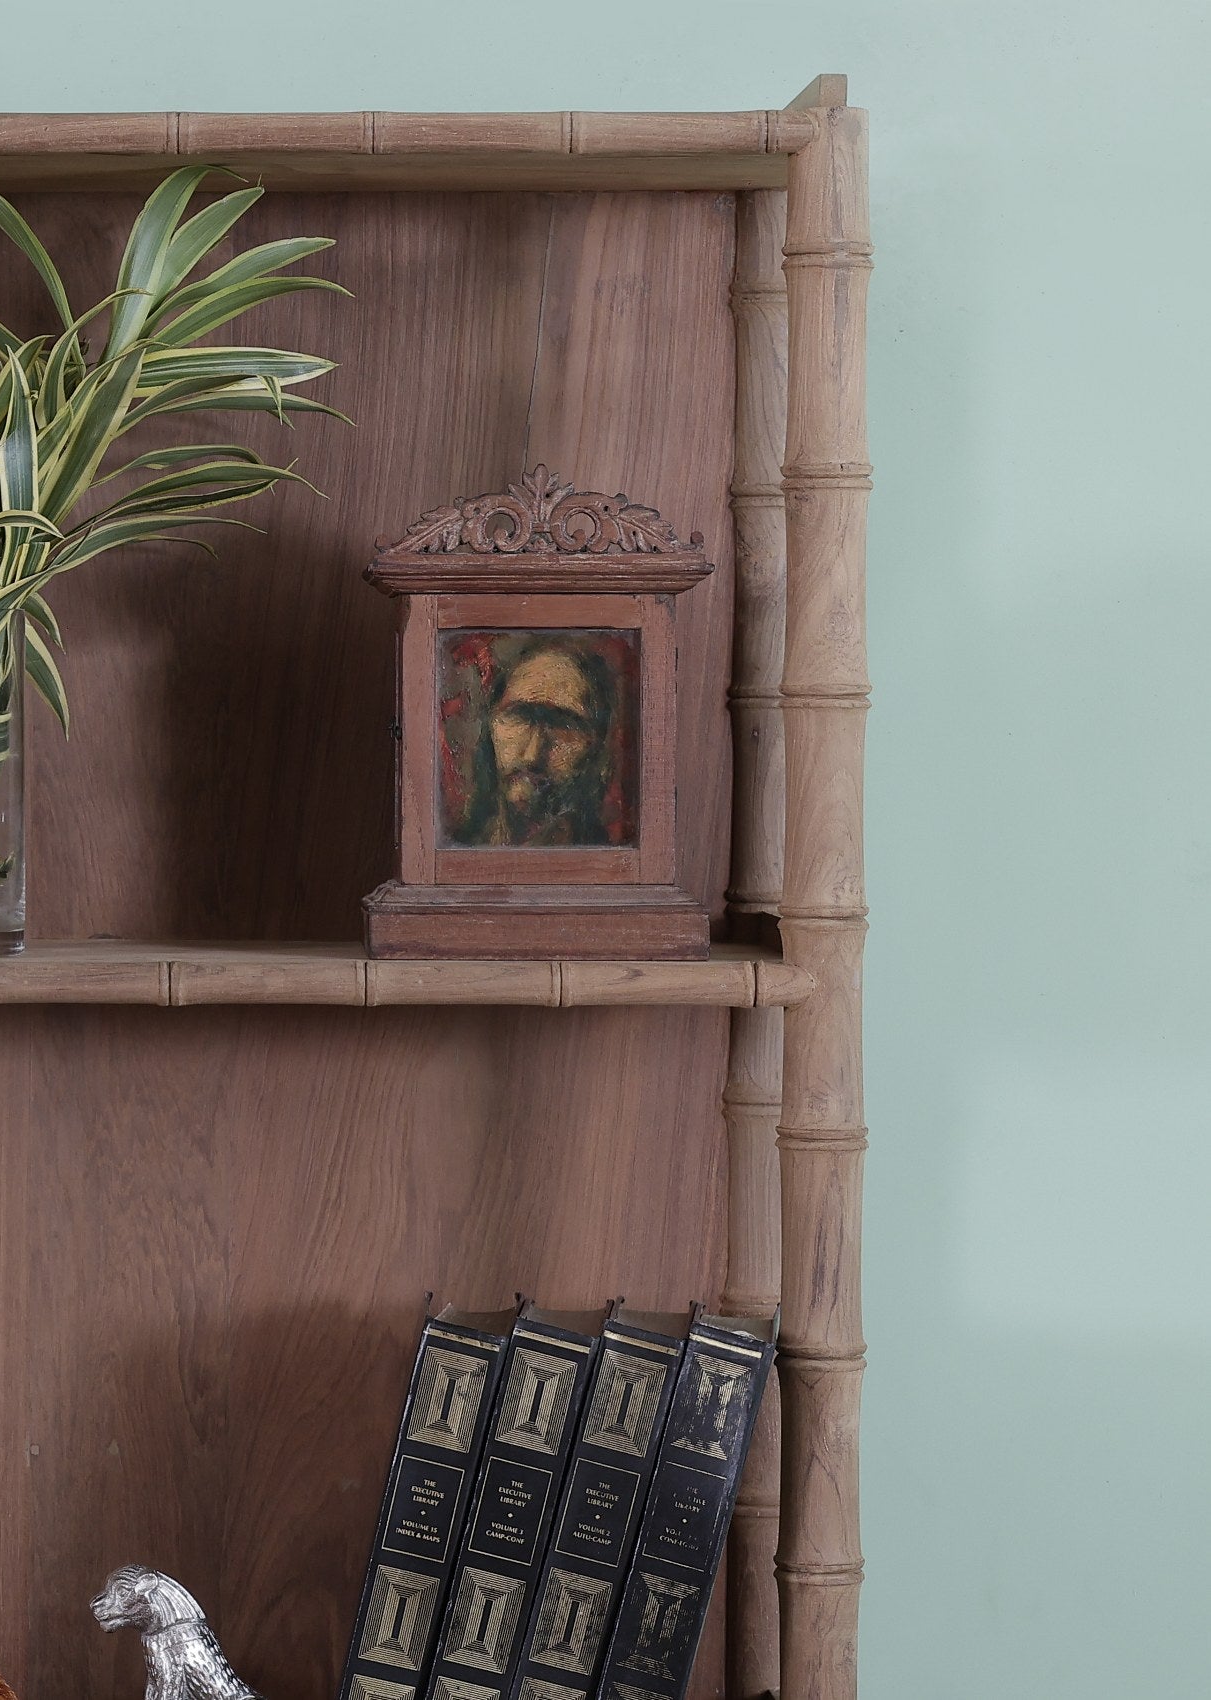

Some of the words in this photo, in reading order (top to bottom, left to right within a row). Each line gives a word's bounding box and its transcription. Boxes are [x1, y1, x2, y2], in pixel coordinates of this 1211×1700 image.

[423, 1479, 436, 1488] THE
[511, 1480, 524, 1488] THE
[598, 1482, 611, 1491] THE
[410, 1485, 445, 1499] EXECUTIVE
[498, 1486, 532, 1500] EXECUTIVE
[585, 1487, 620, 1502] EXECUTIVE
[412, 1494, 439, 1507] LIBRARY
[500, 1496, 527, 1508] LIBRARY
[587, 1497, 614, 1510] LIBRARY
[402, 1519, 429, 1531] VOLUME
[491, 1521, 519, 1533] VOLUME
[578, 1522, 606, 1535] VOLUME
[422, 1534, 441, 1543] MAPS
[485, 1529, 525, 1545] CAMP-CONF
